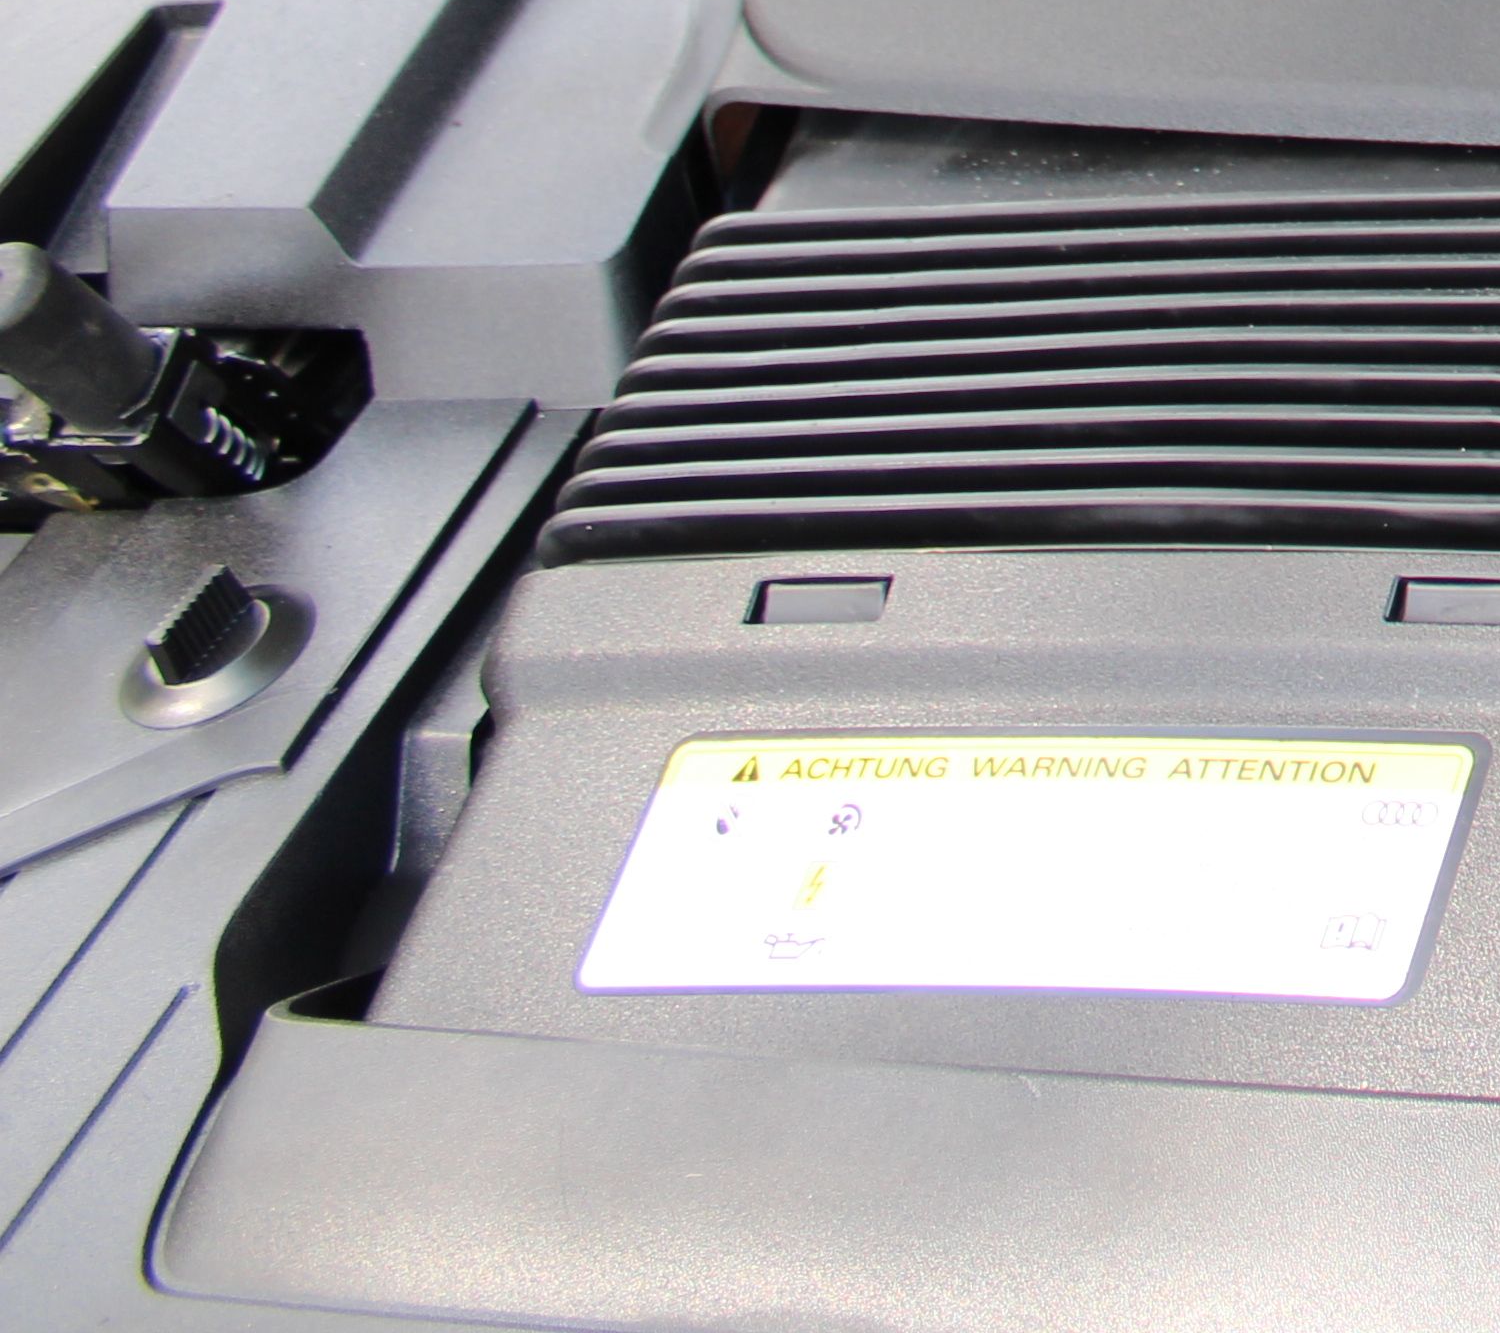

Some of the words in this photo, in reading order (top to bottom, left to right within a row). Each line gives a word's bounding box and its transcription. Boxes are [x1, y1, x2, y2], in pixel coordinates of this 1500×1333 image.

[780, 755, 950, 780] ACHTUNG
[973, 756, 1148, 780] WARNING
[1167, 757, 1377, 784] ATTENTION
